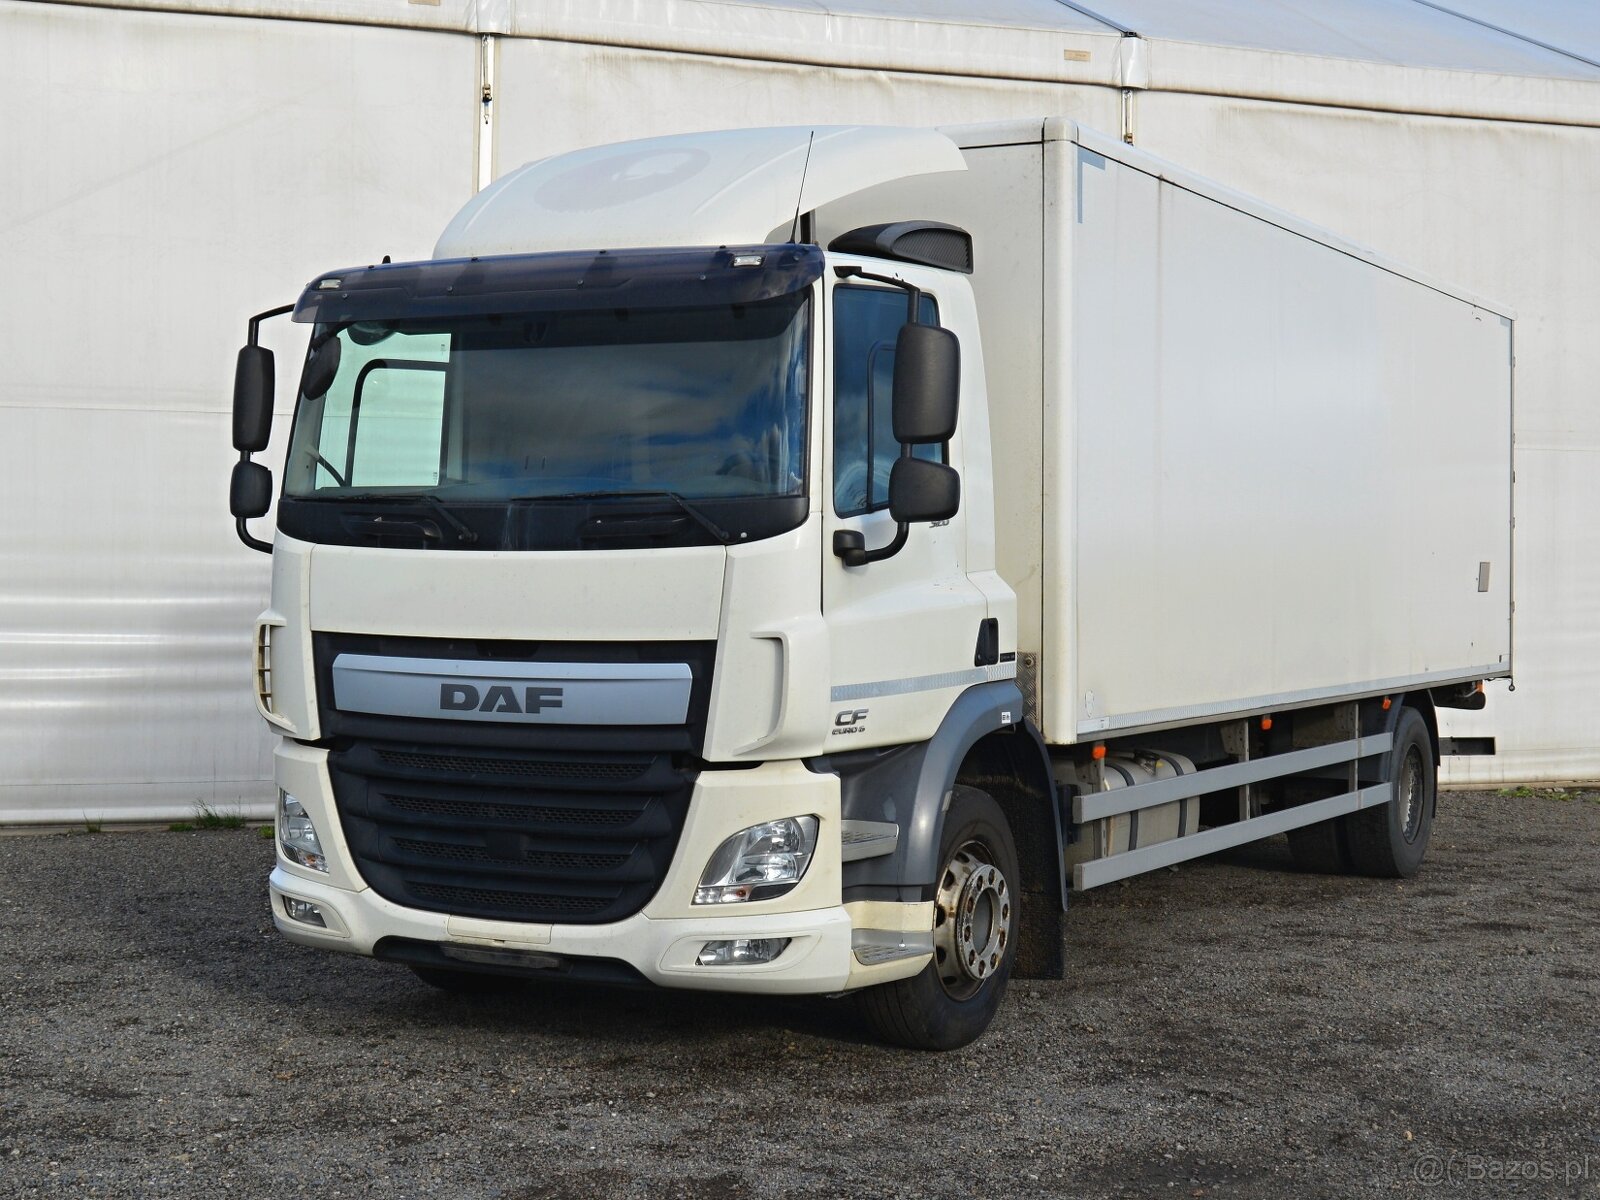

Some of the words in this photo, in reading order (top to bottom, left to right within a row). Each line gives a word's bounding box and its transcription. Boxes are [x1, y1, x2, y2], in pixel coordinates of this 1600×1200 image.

[439, 683, 563, 714] DAF
[834, 708, 869, 726] CF
[831, 726, 857, 735] EURO
